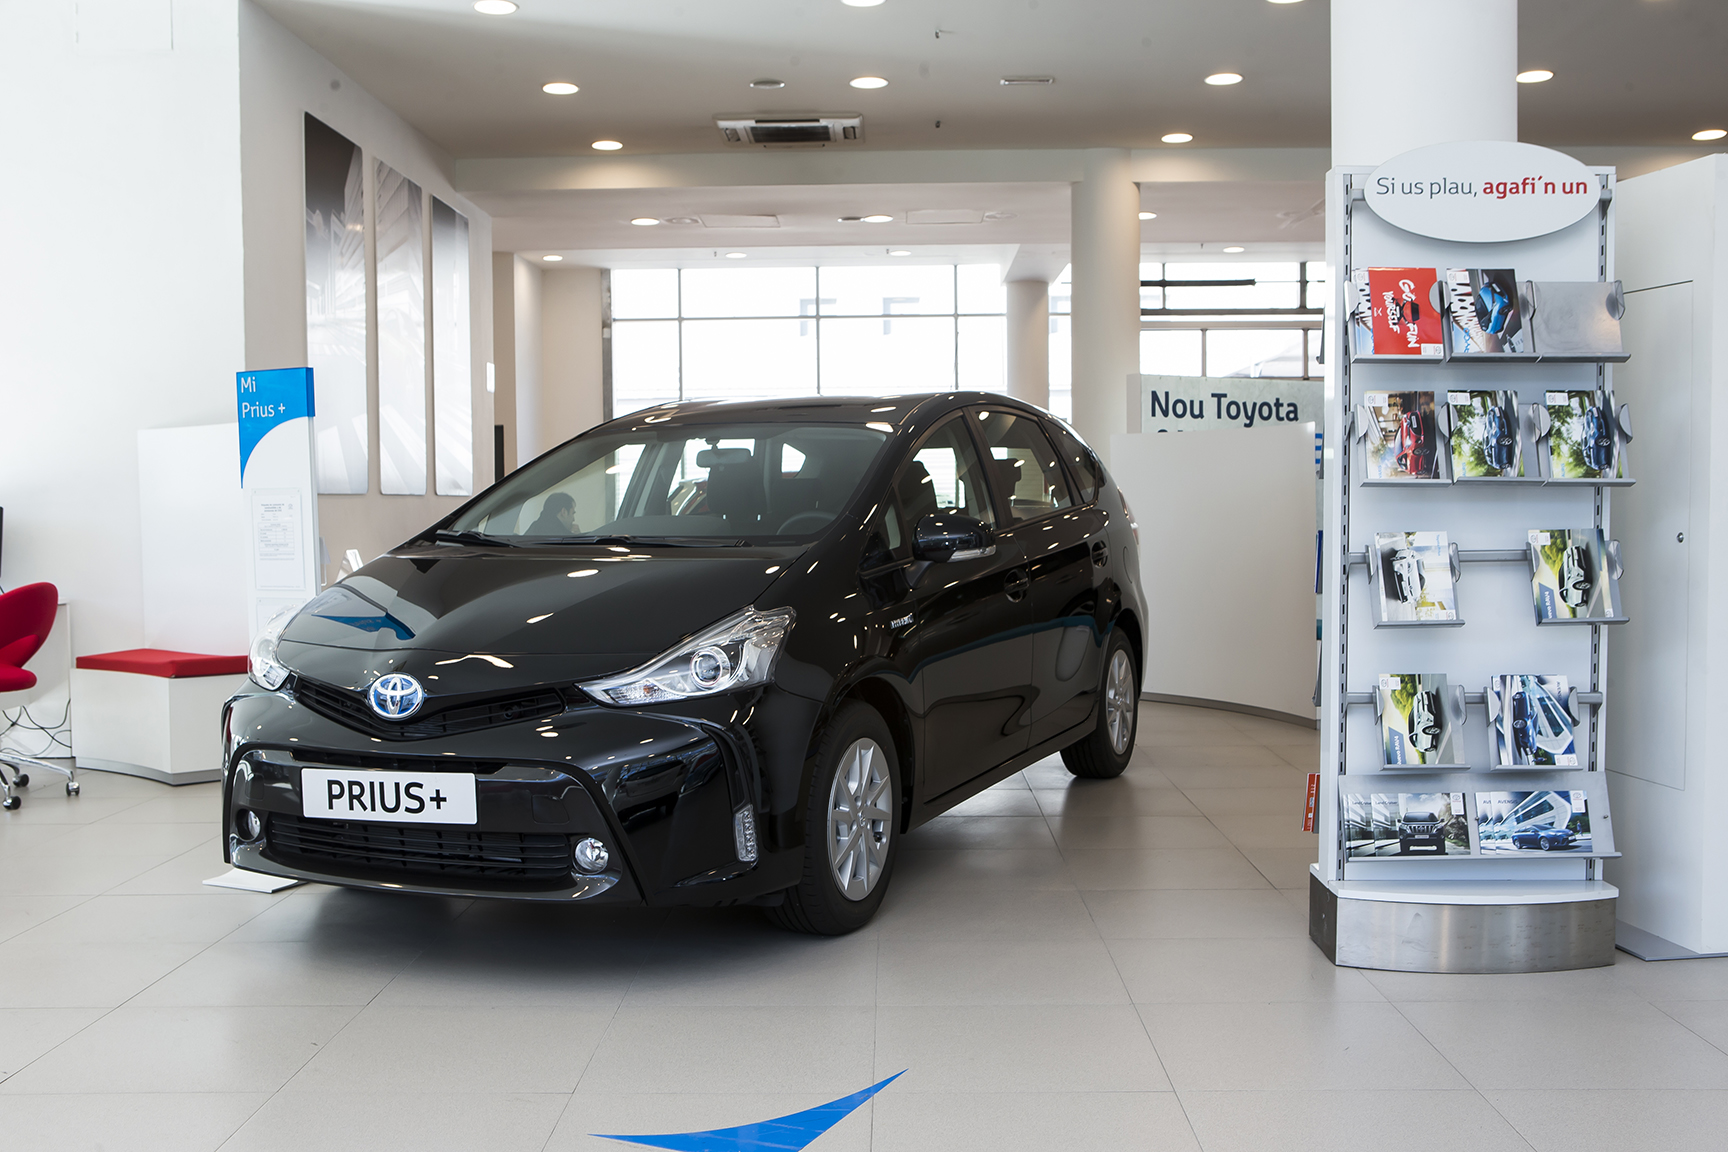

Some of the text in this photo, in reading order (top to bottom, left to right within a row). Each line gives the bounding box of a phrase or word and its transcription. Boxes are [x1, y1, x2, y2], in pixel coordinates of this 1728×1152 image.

[1376, 176, 1397, 196] Si
[1401, 181, 1425, 196] us
[1429, 176, 1478, 200] plau,
[1561, 181, 1588, 196] un
[1382, 290, 1401, 335] YOURSELF
[1398, 279, 1421, 348] GO FUN
[240, 376, 257, 393] Mi
[242, 402, 275, 419] Prius
[1151, 390, 1299, 428] Nou Toyota
[327, 779, 447, 814] PRIUS+
